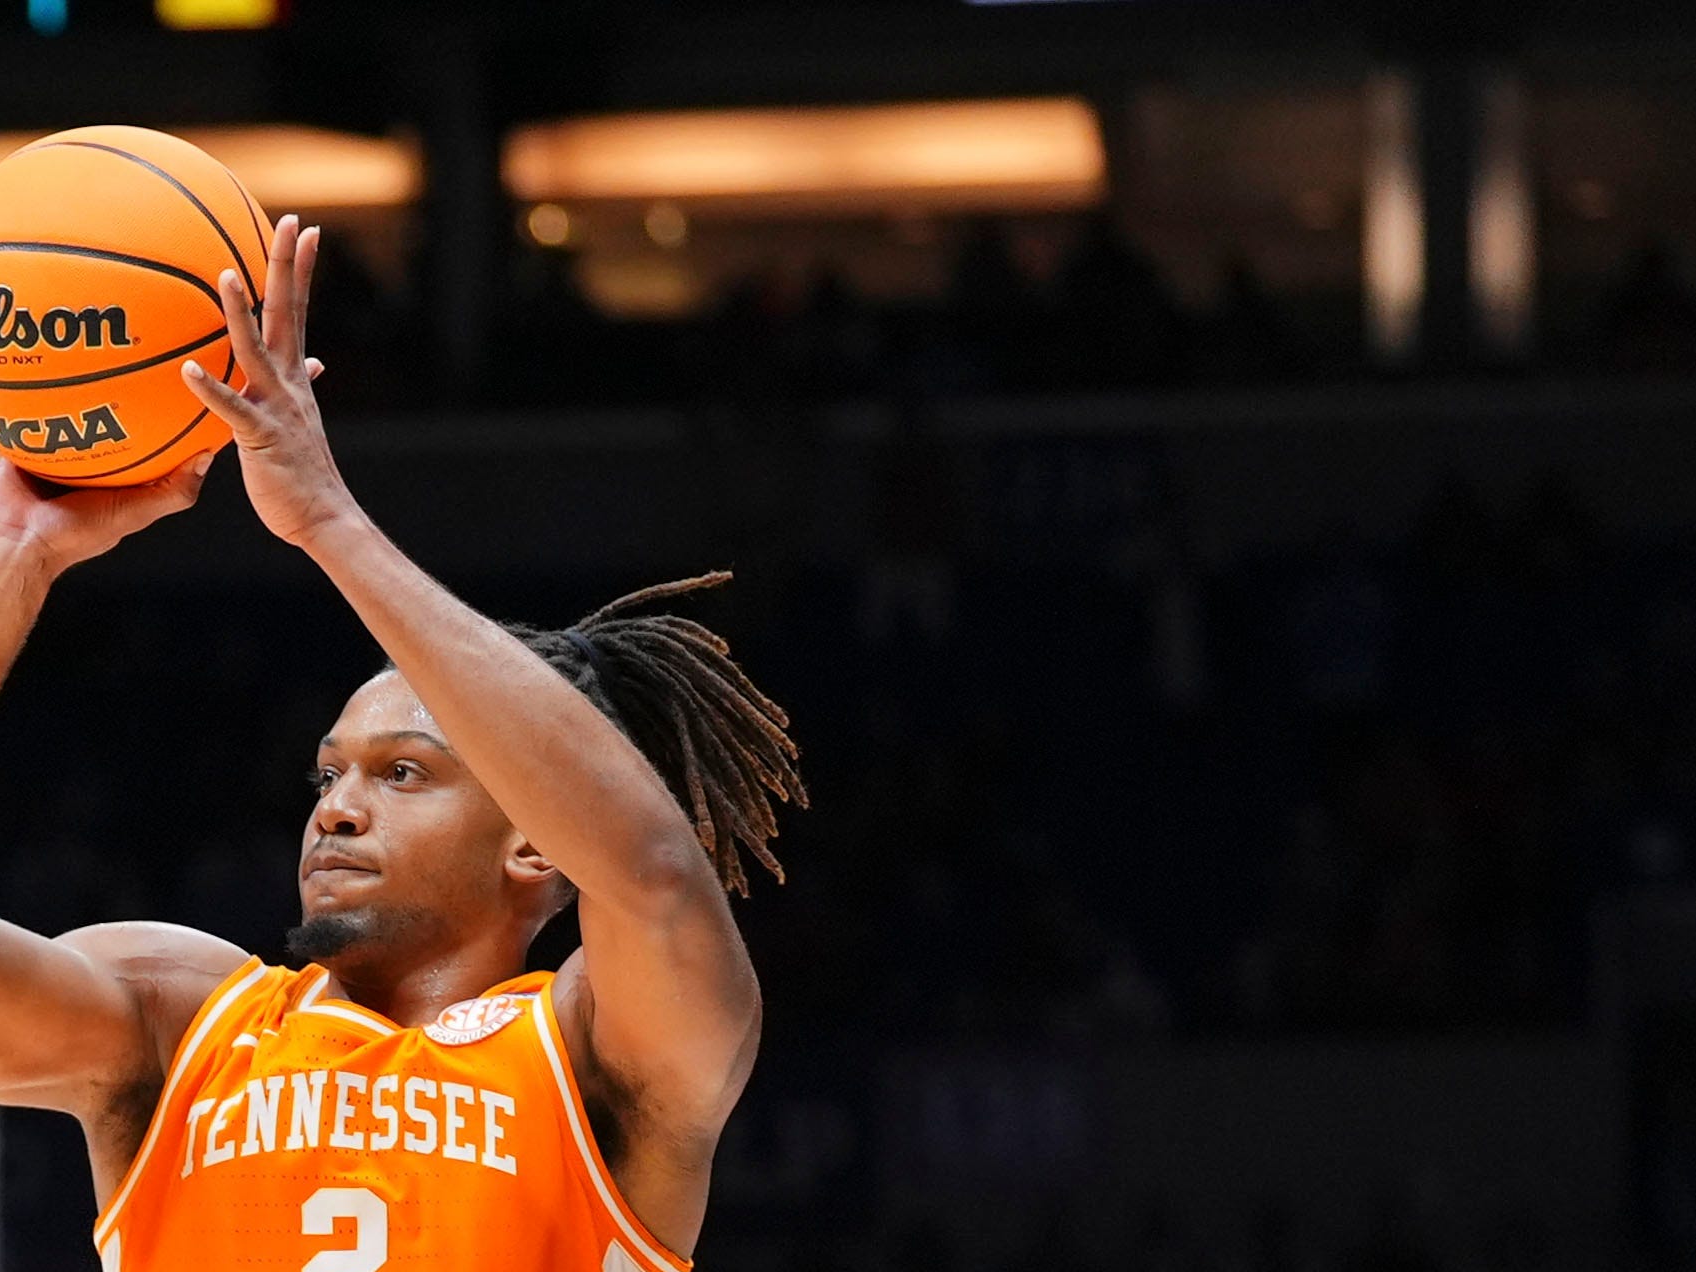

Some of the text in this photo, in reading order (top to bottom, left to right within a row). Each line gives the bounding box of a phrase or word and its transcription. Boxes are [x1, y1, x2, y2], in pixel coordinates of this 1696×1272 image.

[12, 354, 44, 365] NXT
[445, 996, 509, 1030] SEC
[179, 1070, 518, 1180] TENNESSEE
